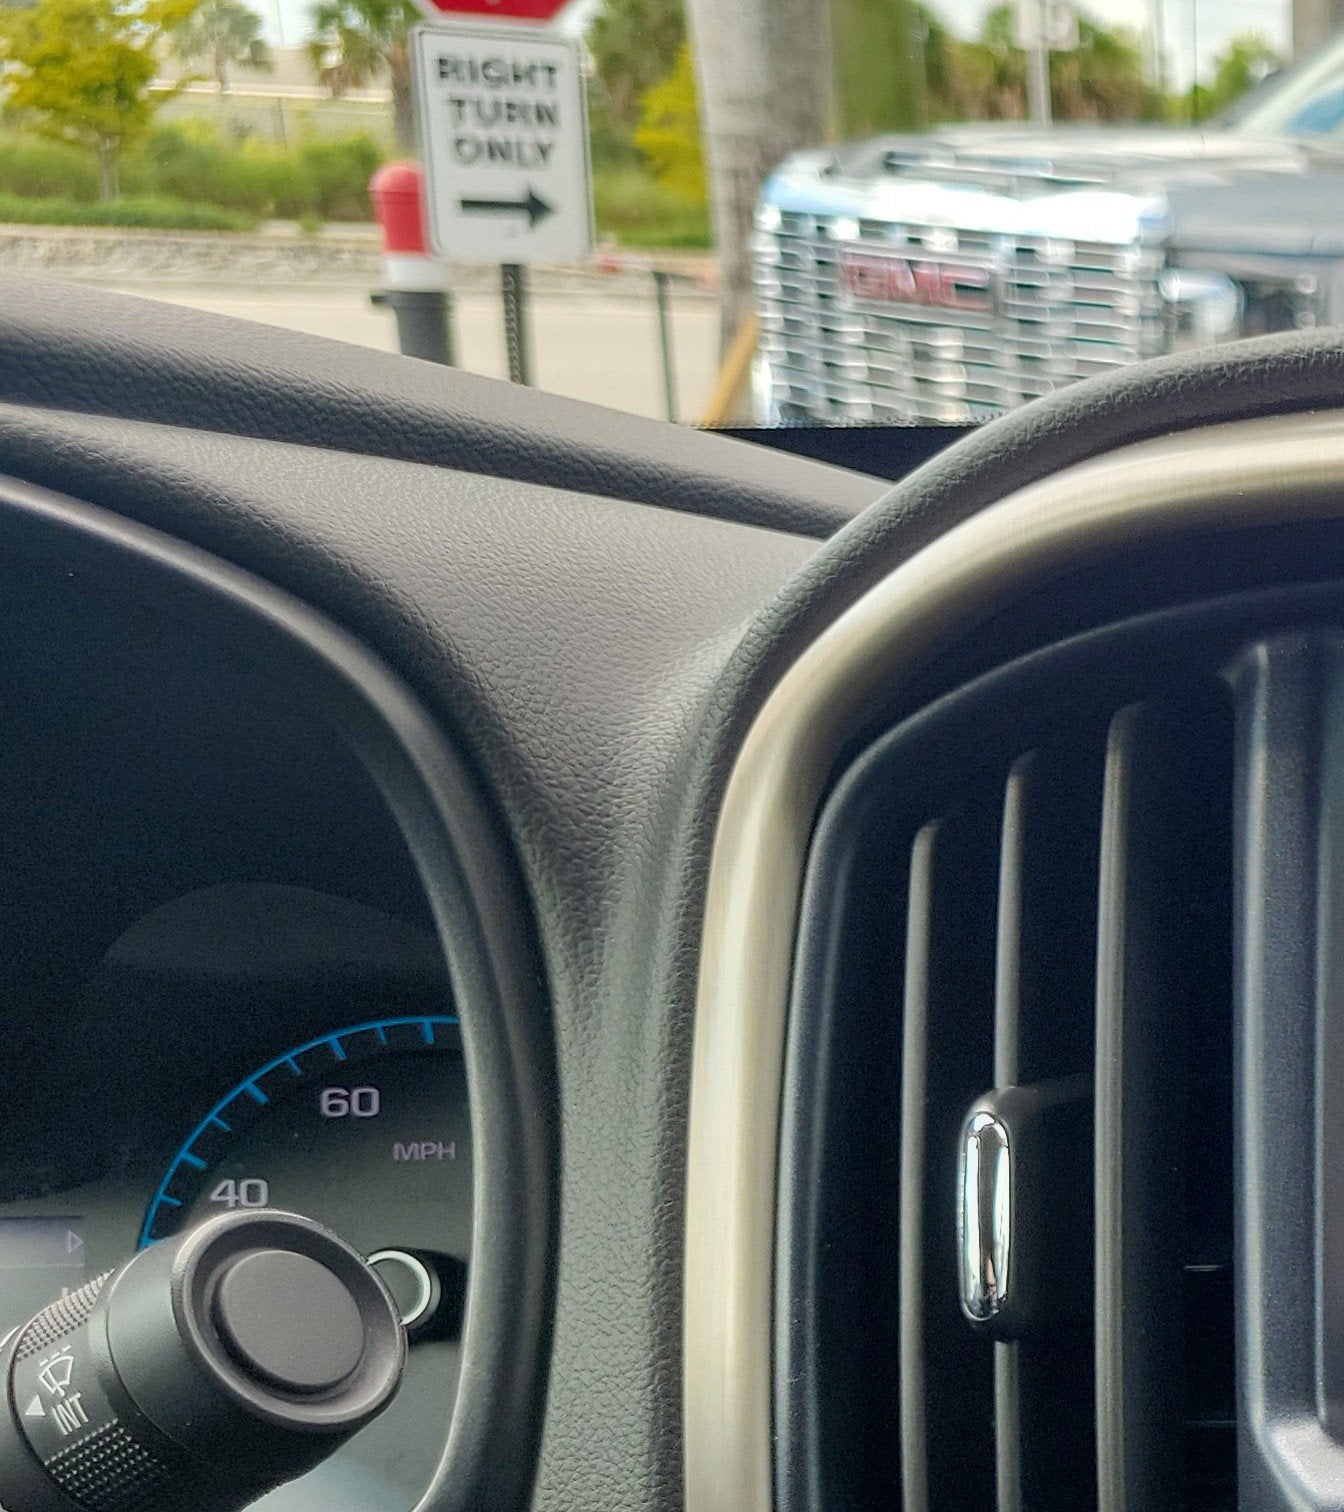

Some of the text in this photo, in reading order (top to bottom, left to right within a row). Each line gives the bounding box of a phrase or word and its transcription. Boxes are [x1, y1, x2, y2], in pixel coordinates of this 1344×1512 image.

[437, 54, 557, 88] RIGHT
[449, 97, 561, 127] TURN
[455, 134, 553, 168] ONLY
[321, 1087, 381, 1118] 60
[392, 1142, 456, 1161] MPH
[210, 1178, 269, 1208] 40
[51, 1392, 89, 1436] INT
